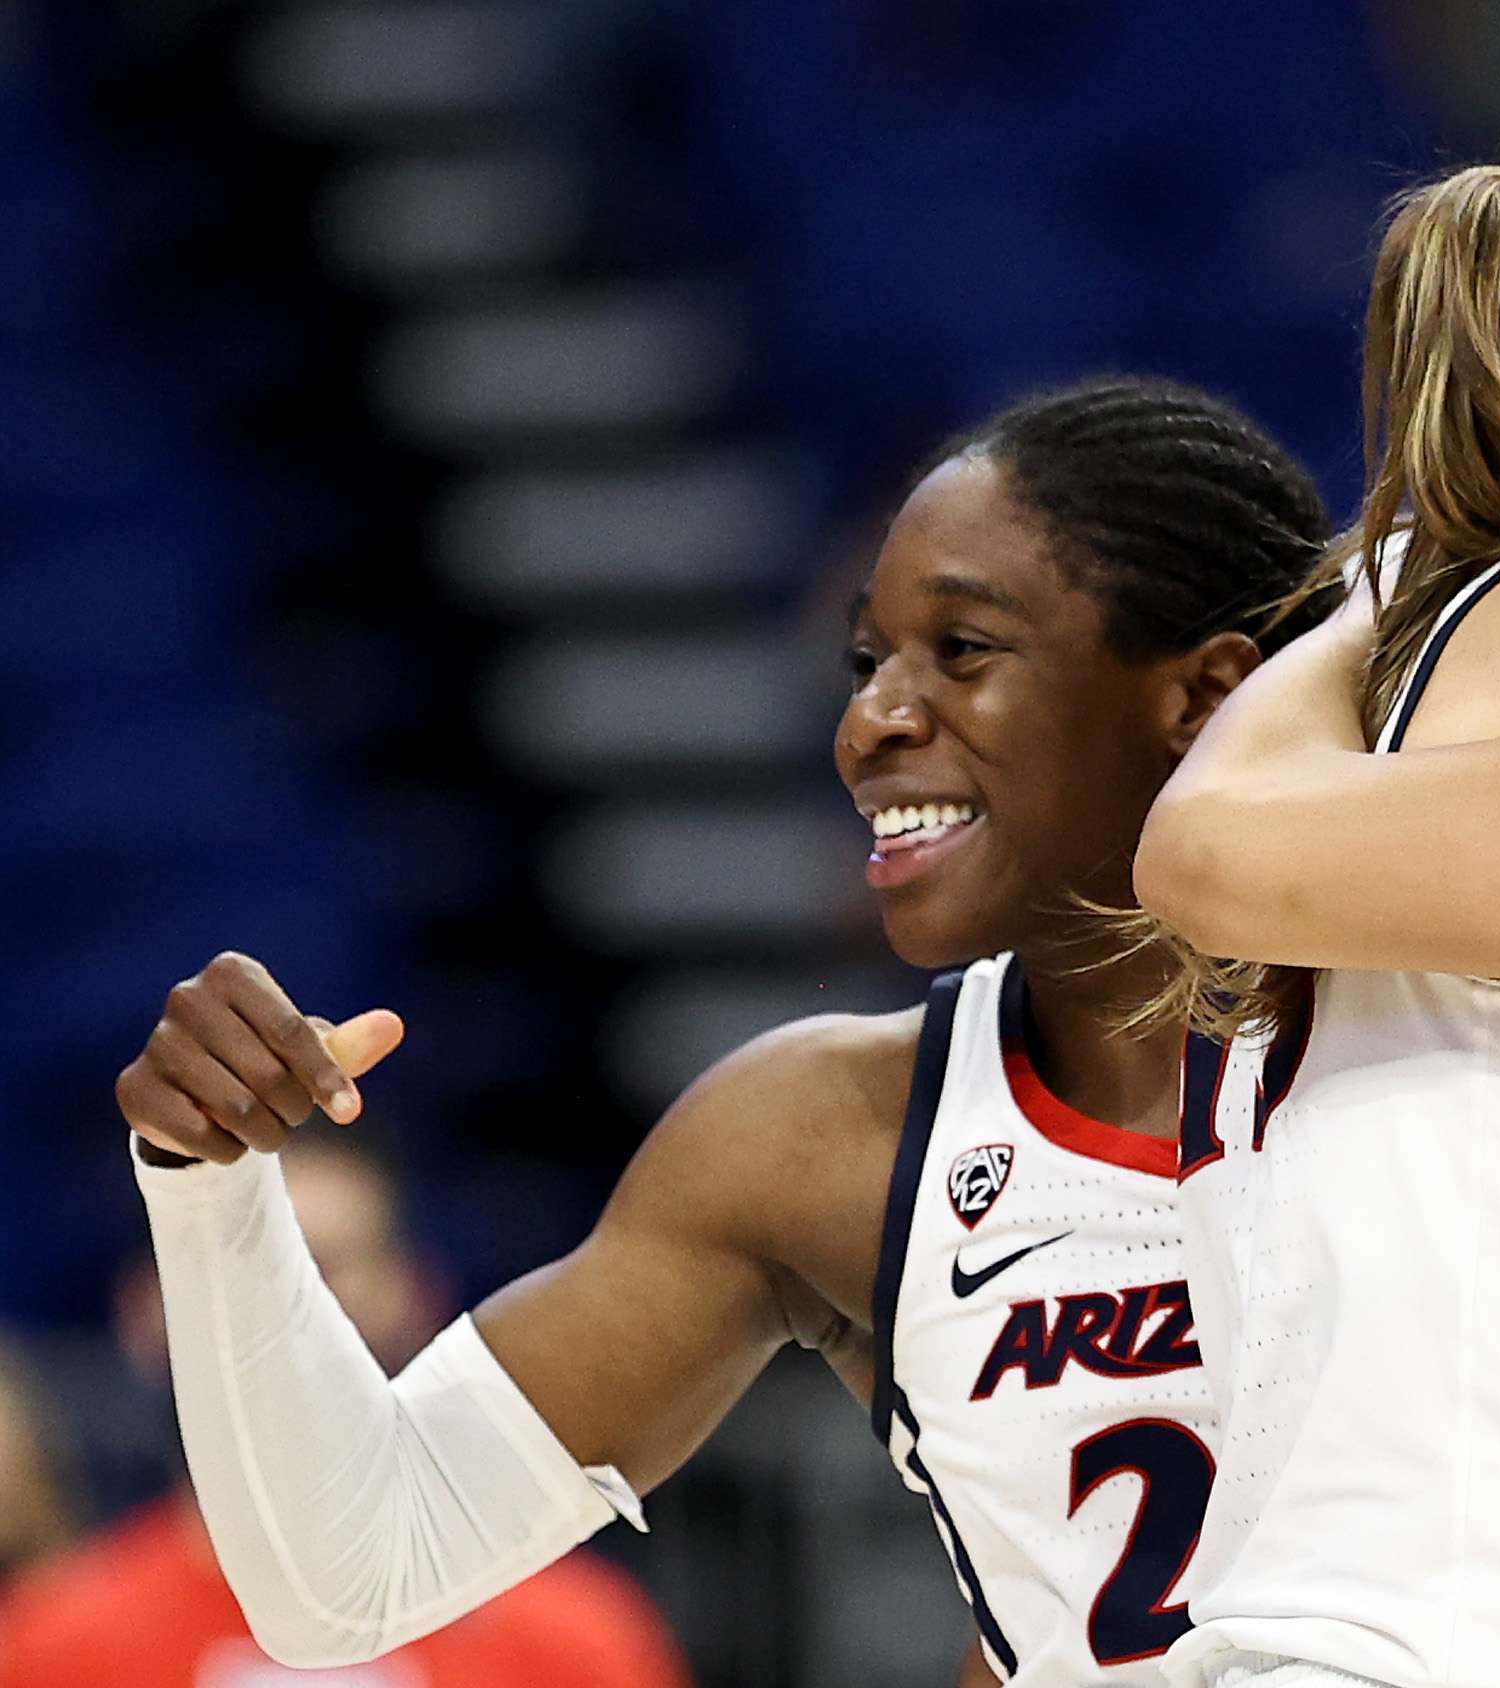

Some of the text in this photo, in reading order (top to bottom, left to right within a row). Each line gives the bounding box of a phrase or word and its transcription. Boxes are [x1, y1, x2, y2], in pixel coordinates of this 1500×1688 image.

[950, 1148, 1010, 1200] PAC
[958, 1177, 992, 1212] 12
[968, 1280, 1203, 1402] ARIZ
[1068, 1416, 1217, 1666] 2
